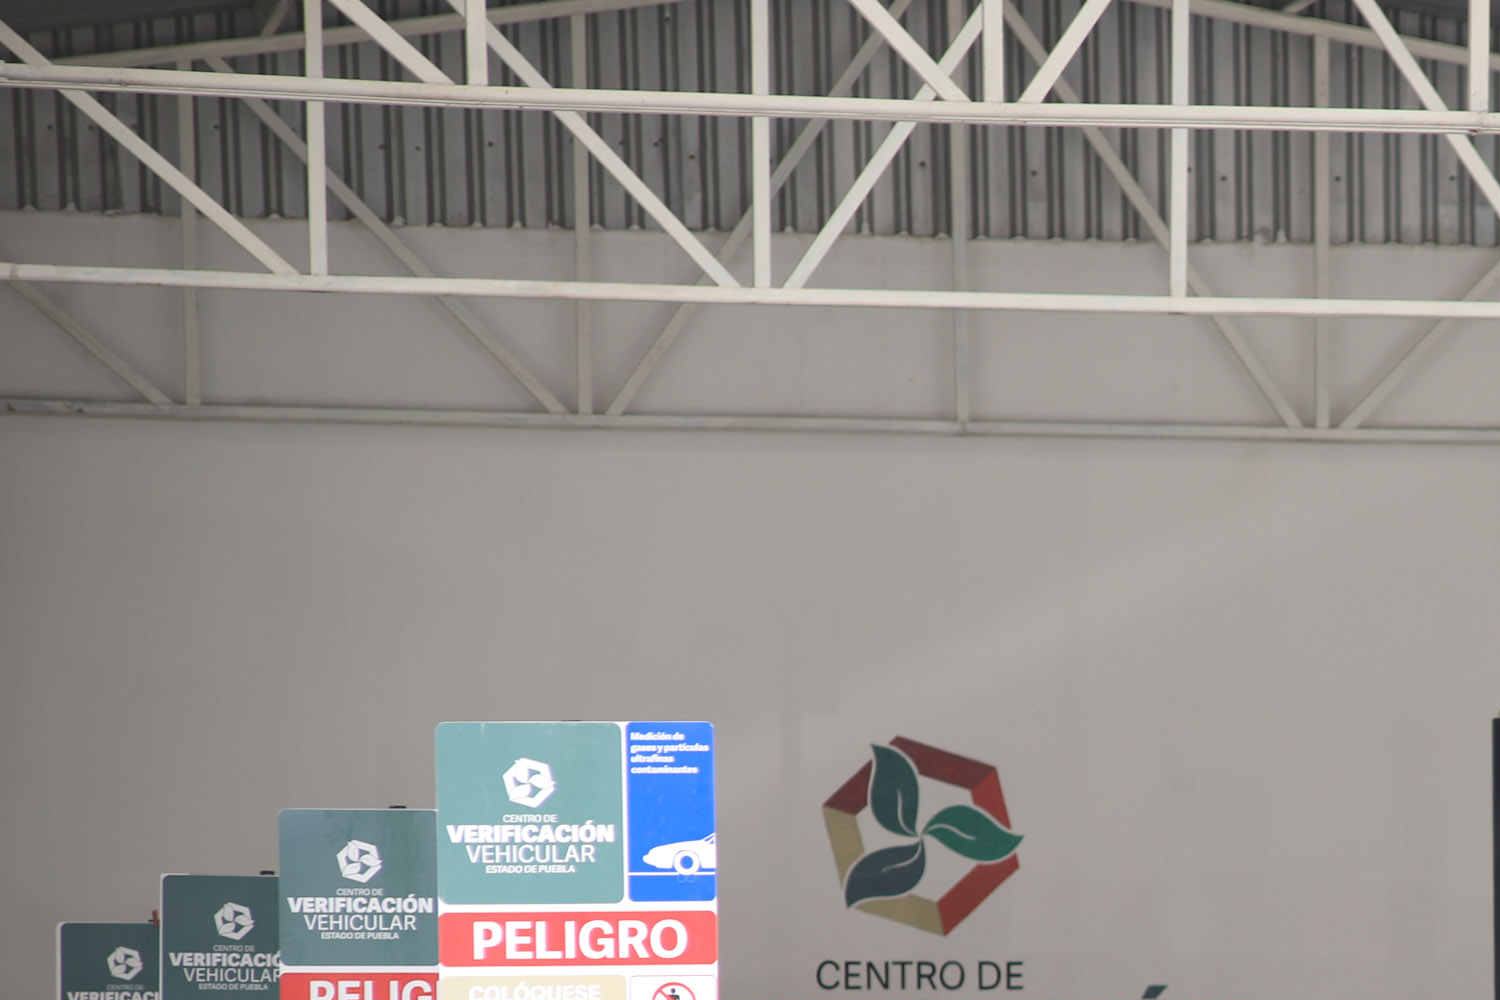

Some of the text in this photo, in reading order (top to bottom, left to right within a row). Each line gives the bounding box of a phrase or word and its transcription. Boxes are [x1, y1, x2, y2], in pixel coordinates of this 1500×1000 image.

[672, 731, 685, 741] de
[630, 742, 710, 753] gases y partículas
[630, 753, 675, 763] ultrafinas
[630, 764, 699, 774] contaminantes
[503, 814, 558, 823] CENTRO DE
[446, 820, 615, 843] VERIFICACIÓN
[465, 844, 596, 864] VEHICULAR
[485, 864, 576, 874] ESTADO DE PUEBLA
[336, 888, 384, 896] CENTRO DE
[287, 894, 433, 913] VERIFICACIÓN
[304, 914, 417, 931] VEHICULAR
[321, 931, 399, 940] ESTADO DE PUEBLA
[472, 919, 688, 960] PELIGRO
[213, 944, 255, 952] CENTRO DE
[169, 951, 281, 967] VERIFICACIÓ
[816, 960, 1024, 991] CENTRO DE
[198, 983, 268, 991] ESTADO DE PUEBLA
